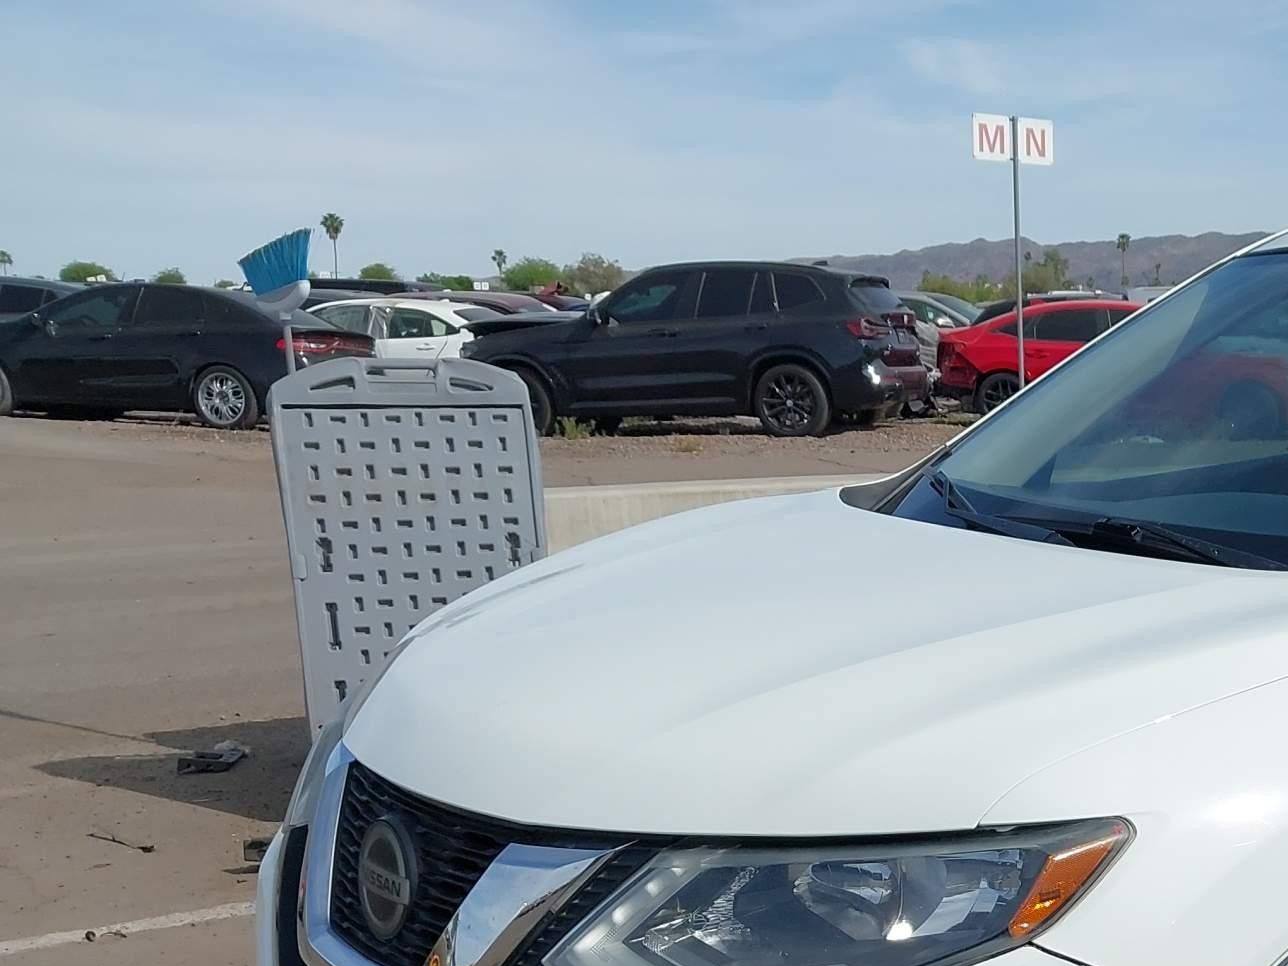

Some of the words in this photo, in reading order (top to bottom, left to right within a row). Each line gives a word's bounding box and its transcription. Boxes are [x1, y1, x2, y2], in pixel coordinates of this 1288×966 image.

[978, 122, 1006, 154] M
[1025, 127, 1046, 158] N
[363, 867, 401, 898] SSAN
